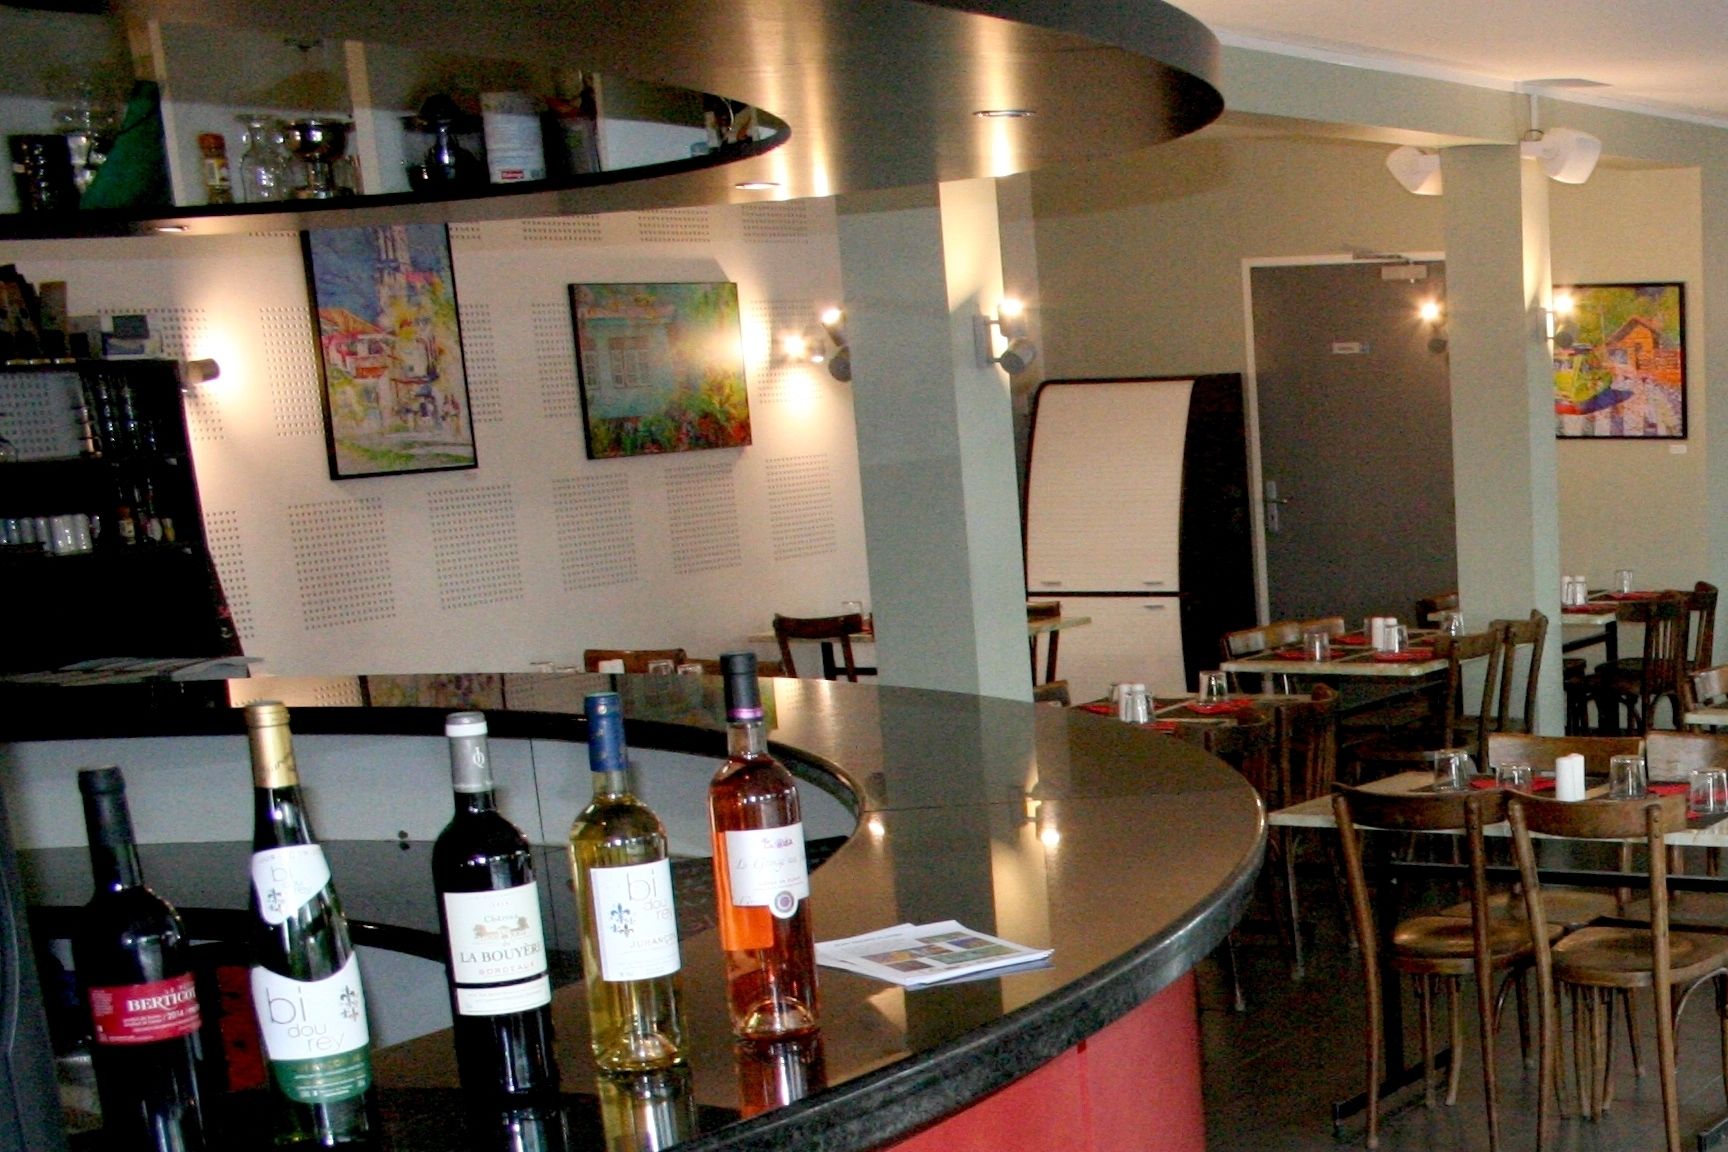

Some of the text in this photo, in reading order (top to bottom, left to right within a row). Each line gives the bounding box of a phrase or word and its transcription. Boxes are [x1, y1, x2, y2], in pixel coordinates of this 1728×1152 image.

[627, 868, 656, 901] bi
[460, 950, 478, 963] LA
[478, 961, 535, 976] BORDEAUX
[266, 985, 306, 1025] bi
[288, 1023, 327, 1038] dou
[307, 1032, 345, 1052] rey
